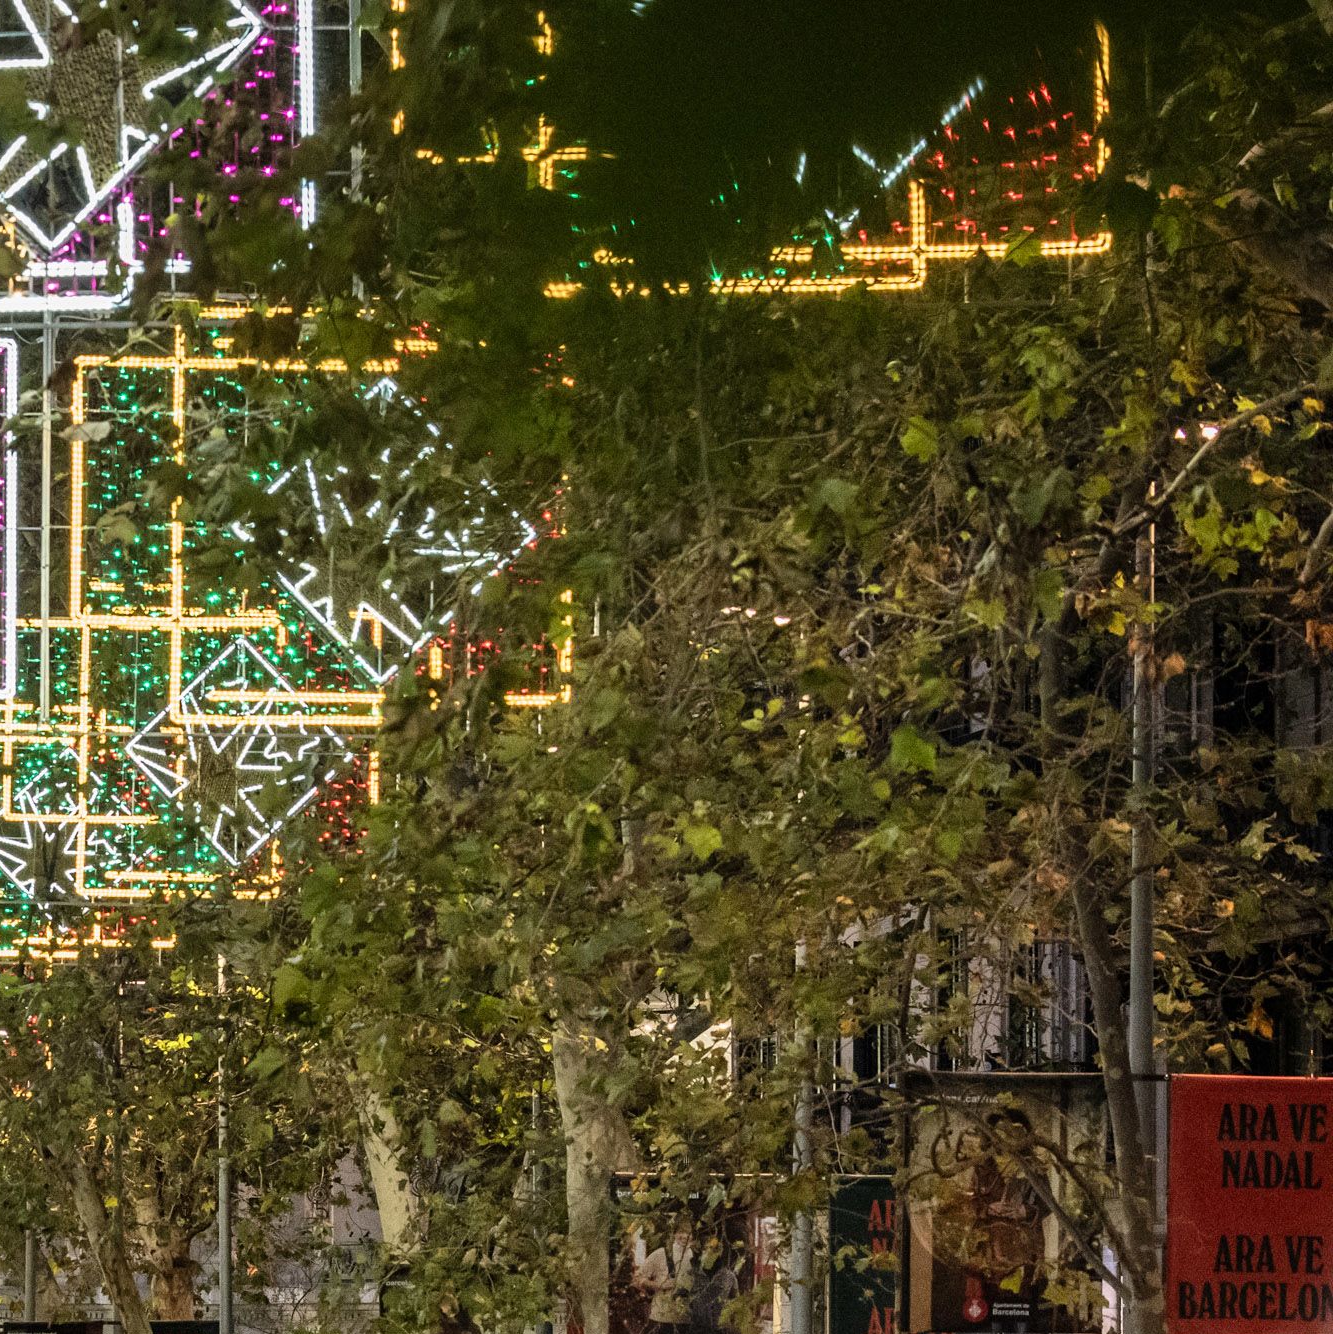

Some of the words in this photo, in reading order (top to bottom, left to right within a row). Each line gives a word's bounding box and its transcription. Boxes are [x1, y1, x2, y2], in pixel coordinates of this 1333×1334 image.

[1218, 1103, 1279, 1142] ARA
[1289, 1104, 1328, 1142] VE
[1222, 1150, 1322, 1189] NADAL
[1213, 1234, 1275, 1273] ARA
[1286, 1235, 1324, 1275] VE
